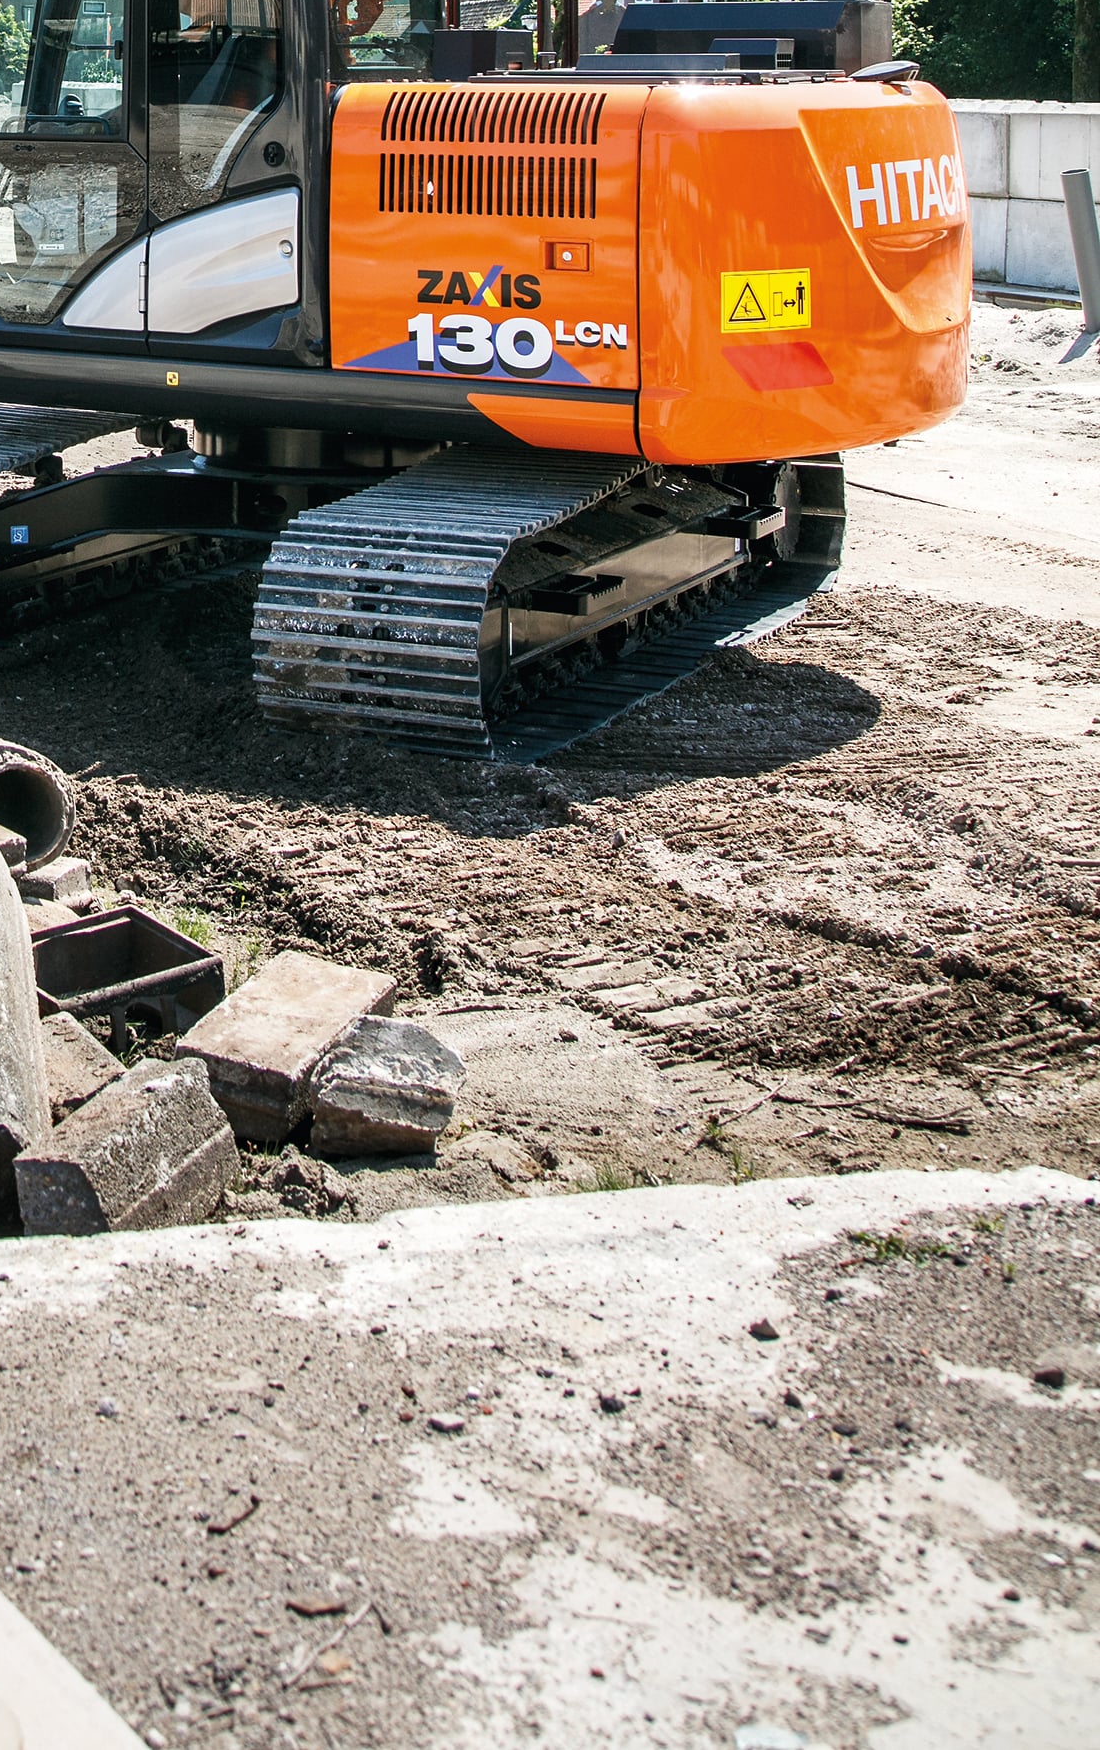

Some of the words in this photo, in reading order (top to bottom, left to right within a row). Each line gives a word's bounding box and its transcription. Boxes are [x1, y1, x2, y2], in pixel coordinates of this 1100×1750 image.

[845, 153, 967, 229] HITACH
[417, 264, 542, 310] ZAXIS
[407, 312, 553, 379] 130
[555, 319, 628, 350] LCN
